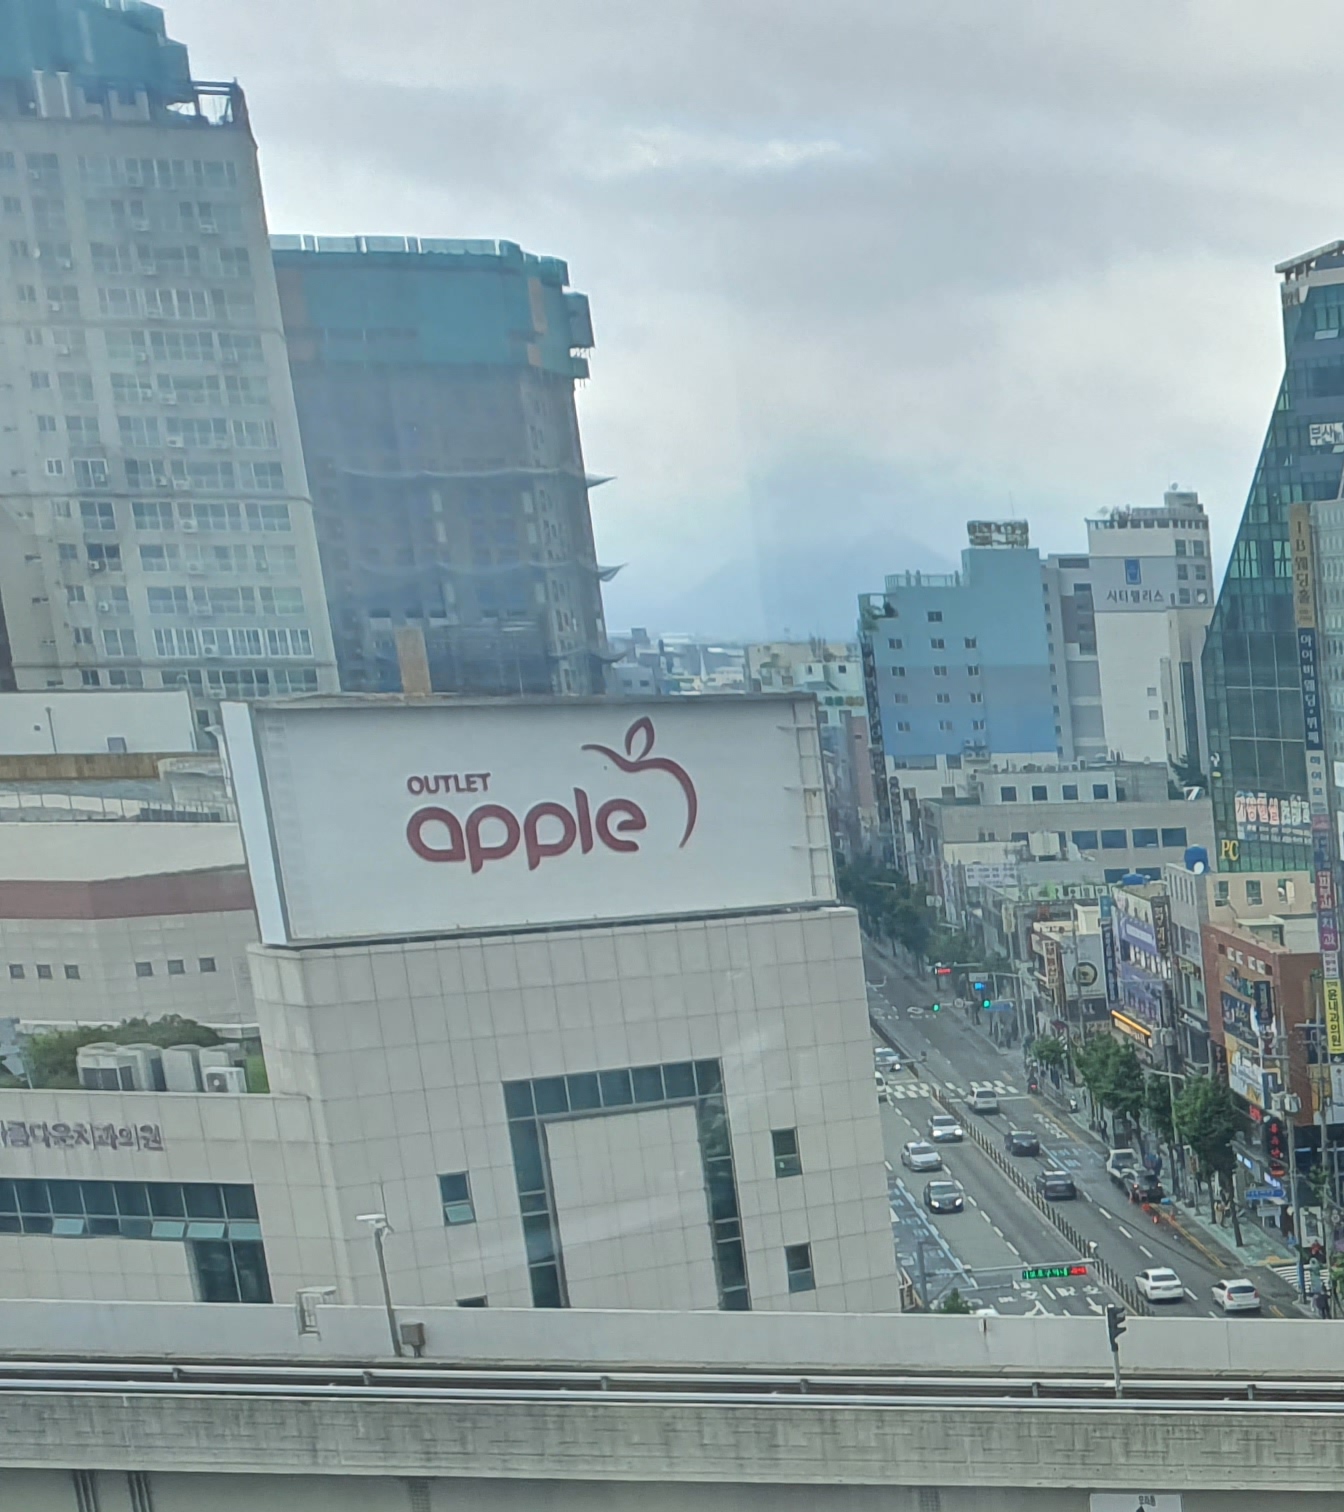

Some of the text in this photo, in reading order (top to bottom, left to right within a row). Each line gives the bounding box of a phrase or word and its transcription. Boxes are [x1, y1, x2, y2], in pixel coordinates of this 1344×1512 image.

[407, 771, 492, 795] OUTLET
[406, 786, 647, 873] apple
[1220, 839, 1239, 861] PC
